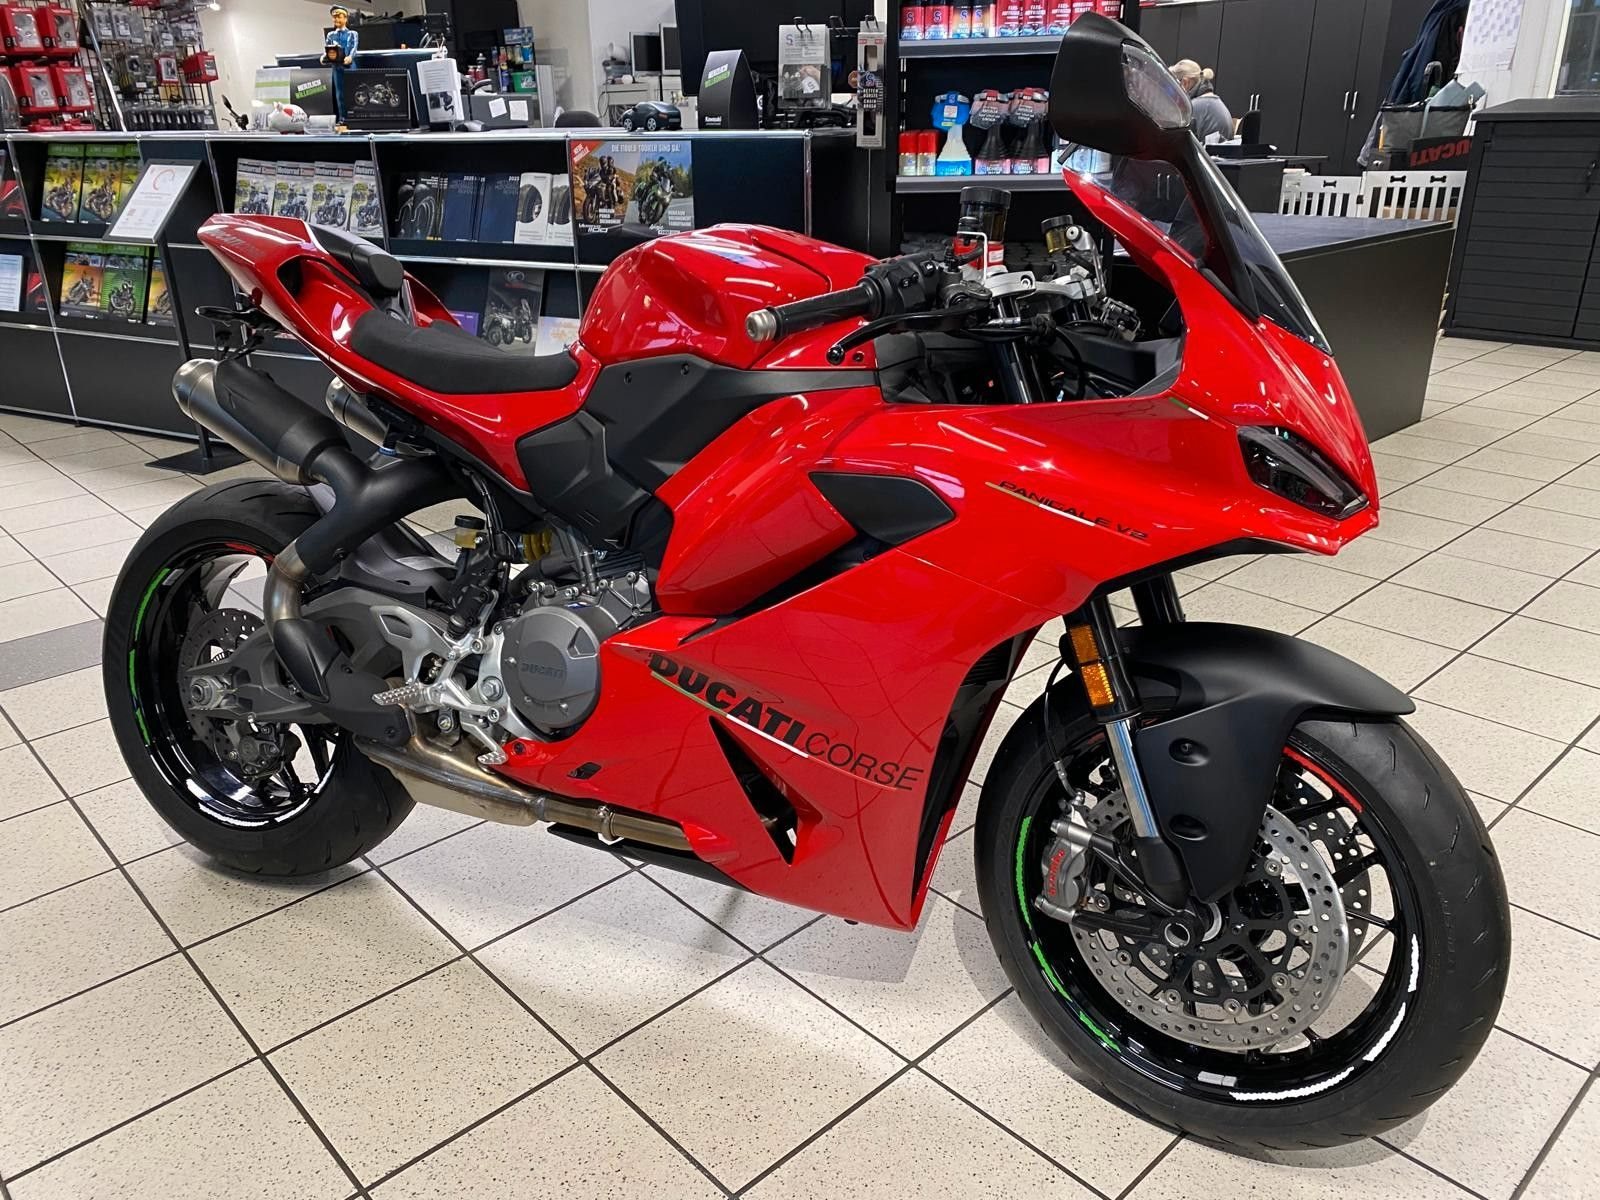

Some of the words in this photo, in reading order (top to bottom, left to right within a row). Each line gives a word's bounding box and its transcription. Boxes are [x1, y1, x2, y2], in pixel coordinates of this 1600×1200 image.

[1410, 138, 1472, 167] UCATI
[999, 481, 1111, 526] PANIGALE
[1116, 523, 1148, 540] V2
[520, 662, 564, 678] DUCATI
[648, 652, 806, 746] DUCATI
[805, 732, 924, 791] CORSE
